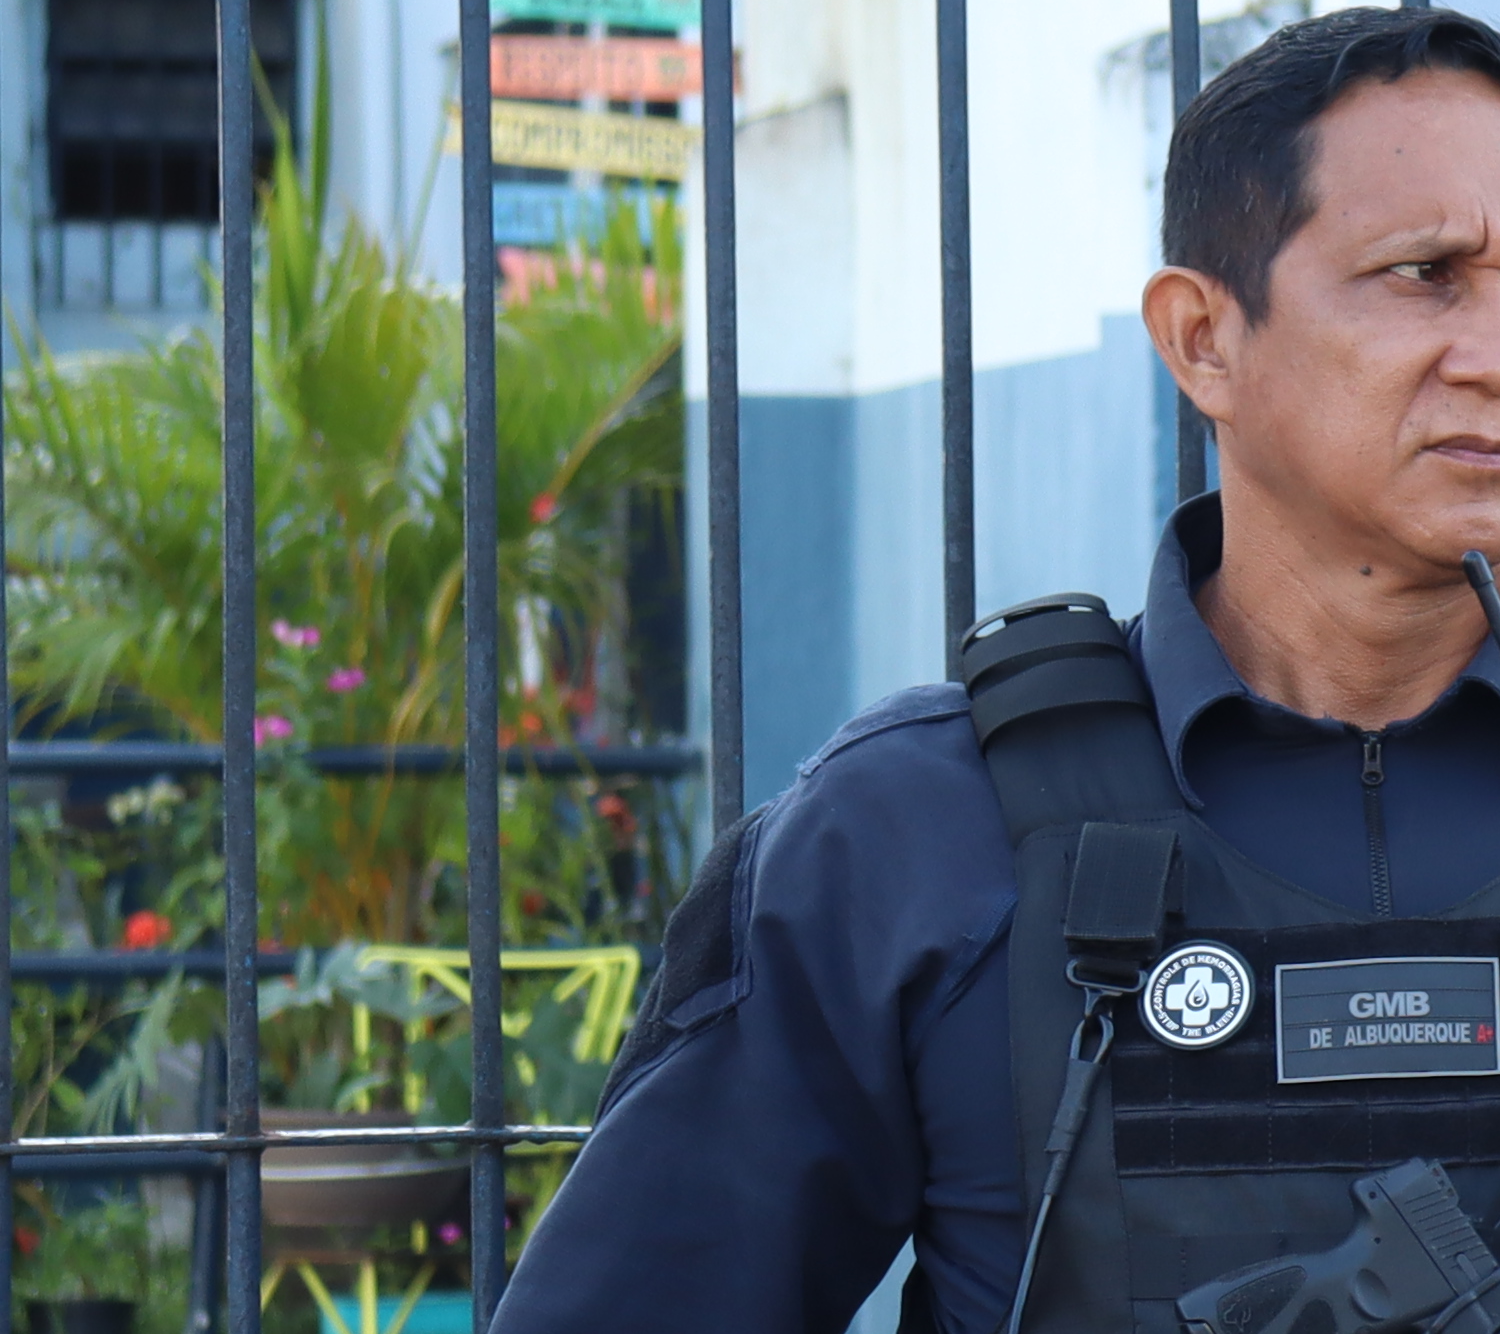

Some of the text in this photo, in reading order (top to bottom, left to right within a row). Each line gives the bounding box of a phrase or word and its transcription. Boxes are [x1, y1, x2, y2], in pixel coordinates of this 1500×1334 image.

[1181, 955, 1196, 967] DE
[1348, 990, 1431, 1019] GMB
[1181, 1027, 1202, 1037] THE
[1309, 1022, 1495, 1050] DE ALBUQUERQUE A+
